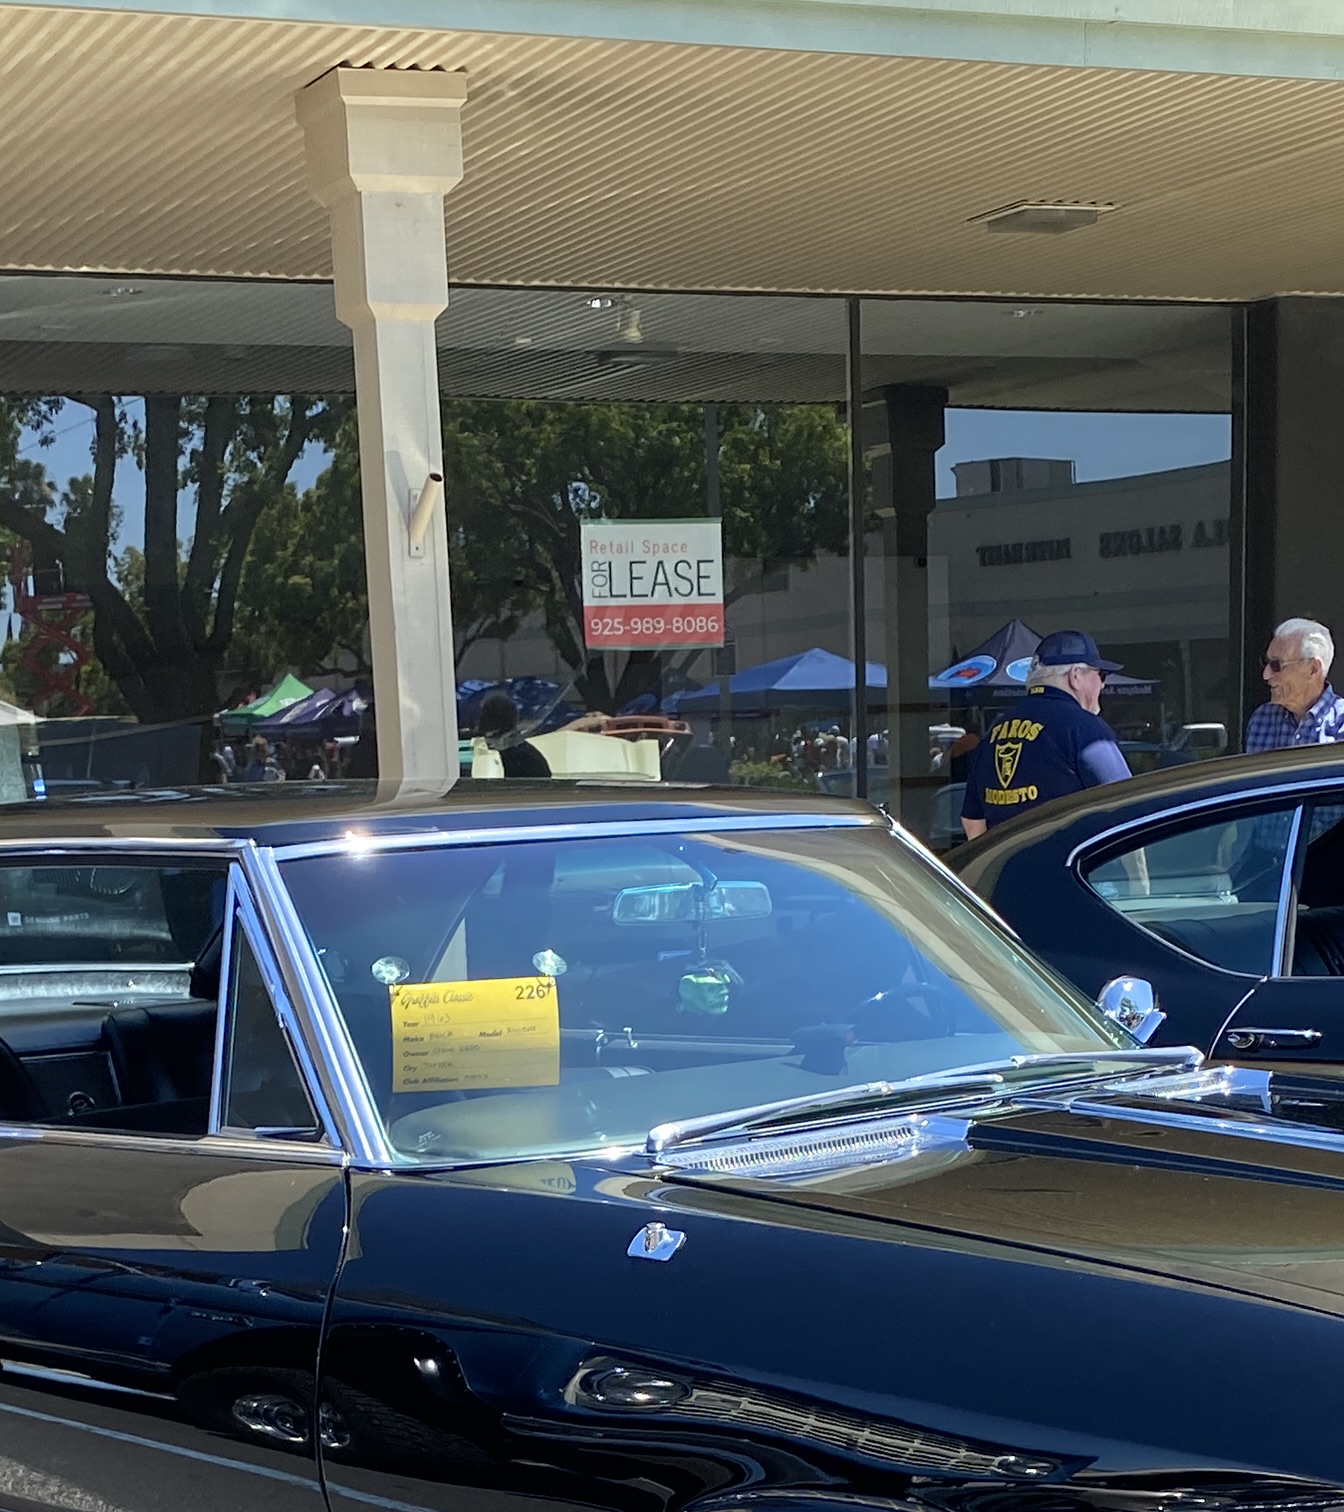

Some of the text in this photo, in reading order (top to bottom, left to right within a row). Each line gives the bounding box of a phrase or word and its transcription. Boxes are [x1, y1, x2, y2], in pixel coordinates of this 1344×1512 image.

[589, 539, 688, 557] Retail Space
[591, 559, 716, 599] FOR LEASE
[590, 616, 719, 635] 925-989-8086
[989, 719, 1045, 743] FAROS
[985, 785, 1038, 805] MODESTO
[515, 984, 546, 1000] 226
